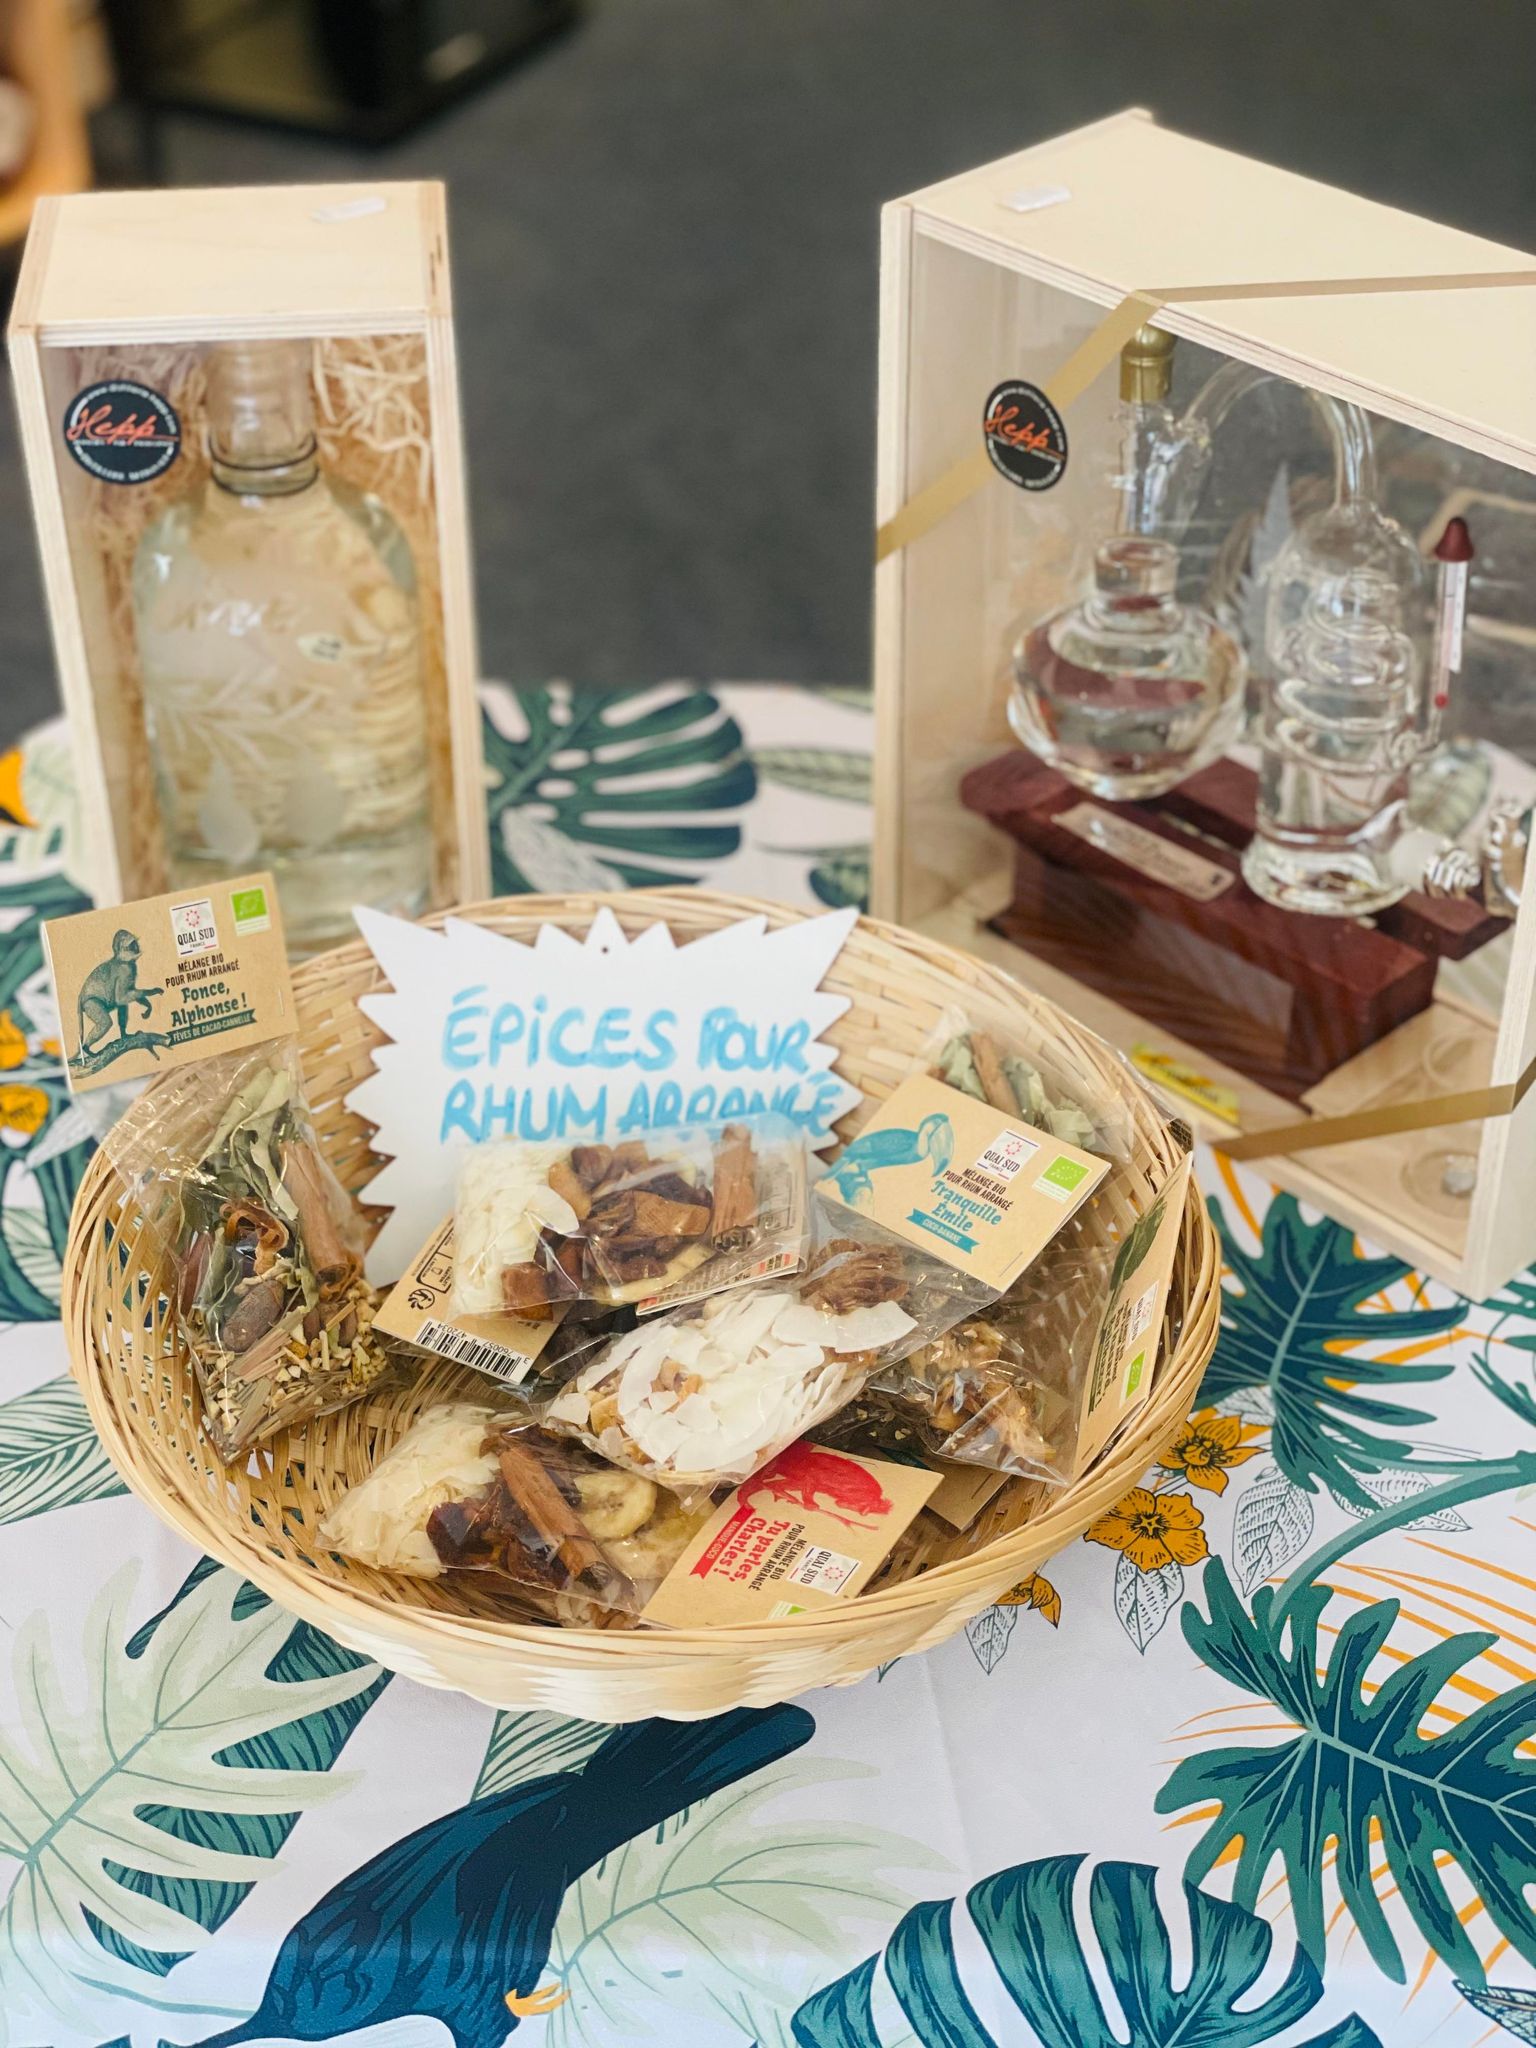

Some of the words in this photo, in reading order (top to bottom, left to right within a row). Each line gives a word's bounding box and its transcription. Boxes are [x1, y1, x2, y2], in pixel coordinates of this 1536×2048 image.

[177, 931, 197, 946] QUAI
[199, 927, 215, 940] SUD
[165, 974, 185, 988] POUR
[187, 969, 207, 983] RHUM
[209, 958, 240, 976] ARRANGÉ
[178, 956, 210, 973] MÉLANGE
[212, 953, 224, 965] BIO
[181, 982, 230, 1004] Fonce,
[171, 998, 239, 1027] Alphonse
[241, 992, 248, 1008] !
[192, 1026, 201, 1037] DE
[697, 1005, 812, 1074] POUR
[440, 1078, 608, 1144] RHUM
[983, 1150, 1004, 1165] QUAI
[1002, 1158, 1020, 1172] SUD
[942, 1170, 962, 1184] POUR
[961, 1179, 982, 1195] RHUM
[981, 1189, 1014, 1211] ARRANGÉ
[962, 1168, 994, 1189] MÉLANGE
[991, 1182, 1007, 1195] BIO
[930, 1180, 1002, 1225] Tranquille
[931, 1200, 973, 1232] Émile
[437, 1323, 467, 1339] 472034
[483, 1341, 514, 1357] 760057
[522, 1357, 531, 1366] 3
[766, 1520, 791, 1535] Tu
[785, 1523, 805, 1541] POUR
[719, 1517, 767, 1566] Charles
[771, 1540, 792, 1559] RHUM
[729, 1535, 774, 1582] parles,
[779, 1539, 807, 1567] MÉLANGE
[811, 1551, 832, 1569] QUAI
[713, 1568, 730, 1576] !
[748, 1559, 777, 1591] ARRANGÉ
[770, 1567, 785, 1580] BIO
[800, 1568, 818, 1584] SUD
